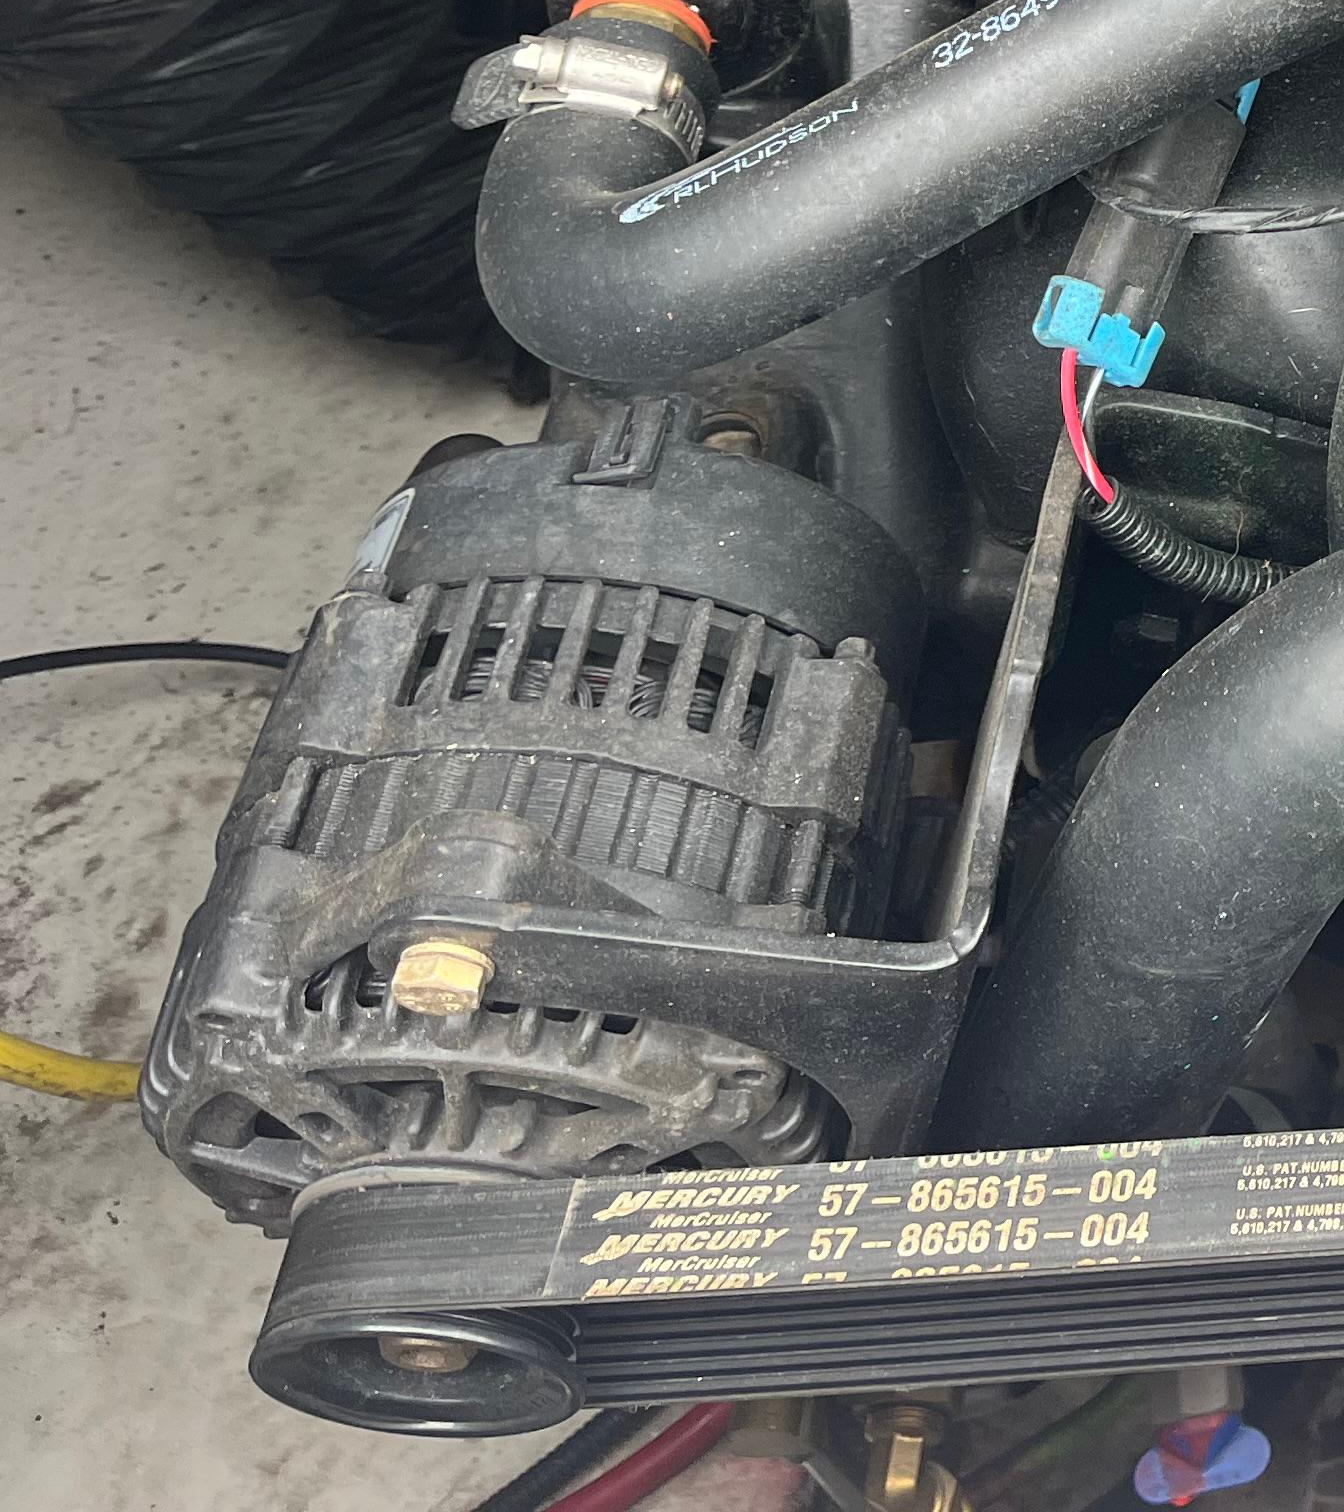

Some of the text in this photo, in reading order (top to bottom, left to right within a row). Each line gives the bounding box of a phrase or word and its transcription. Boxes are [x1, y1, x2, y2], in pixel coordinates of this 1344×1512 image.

[674, 99, 859, 203] RLHUDSON
[1242, 1165, 1267, 1176] U.S.
[592, 1184, 800, 1221] MERCURY
[650, 1211, 772, 1229] MerCruiser
[580, 1228, 790, 1266] MERCURY
[638, 1254, 761, 1273] MerCruiser
